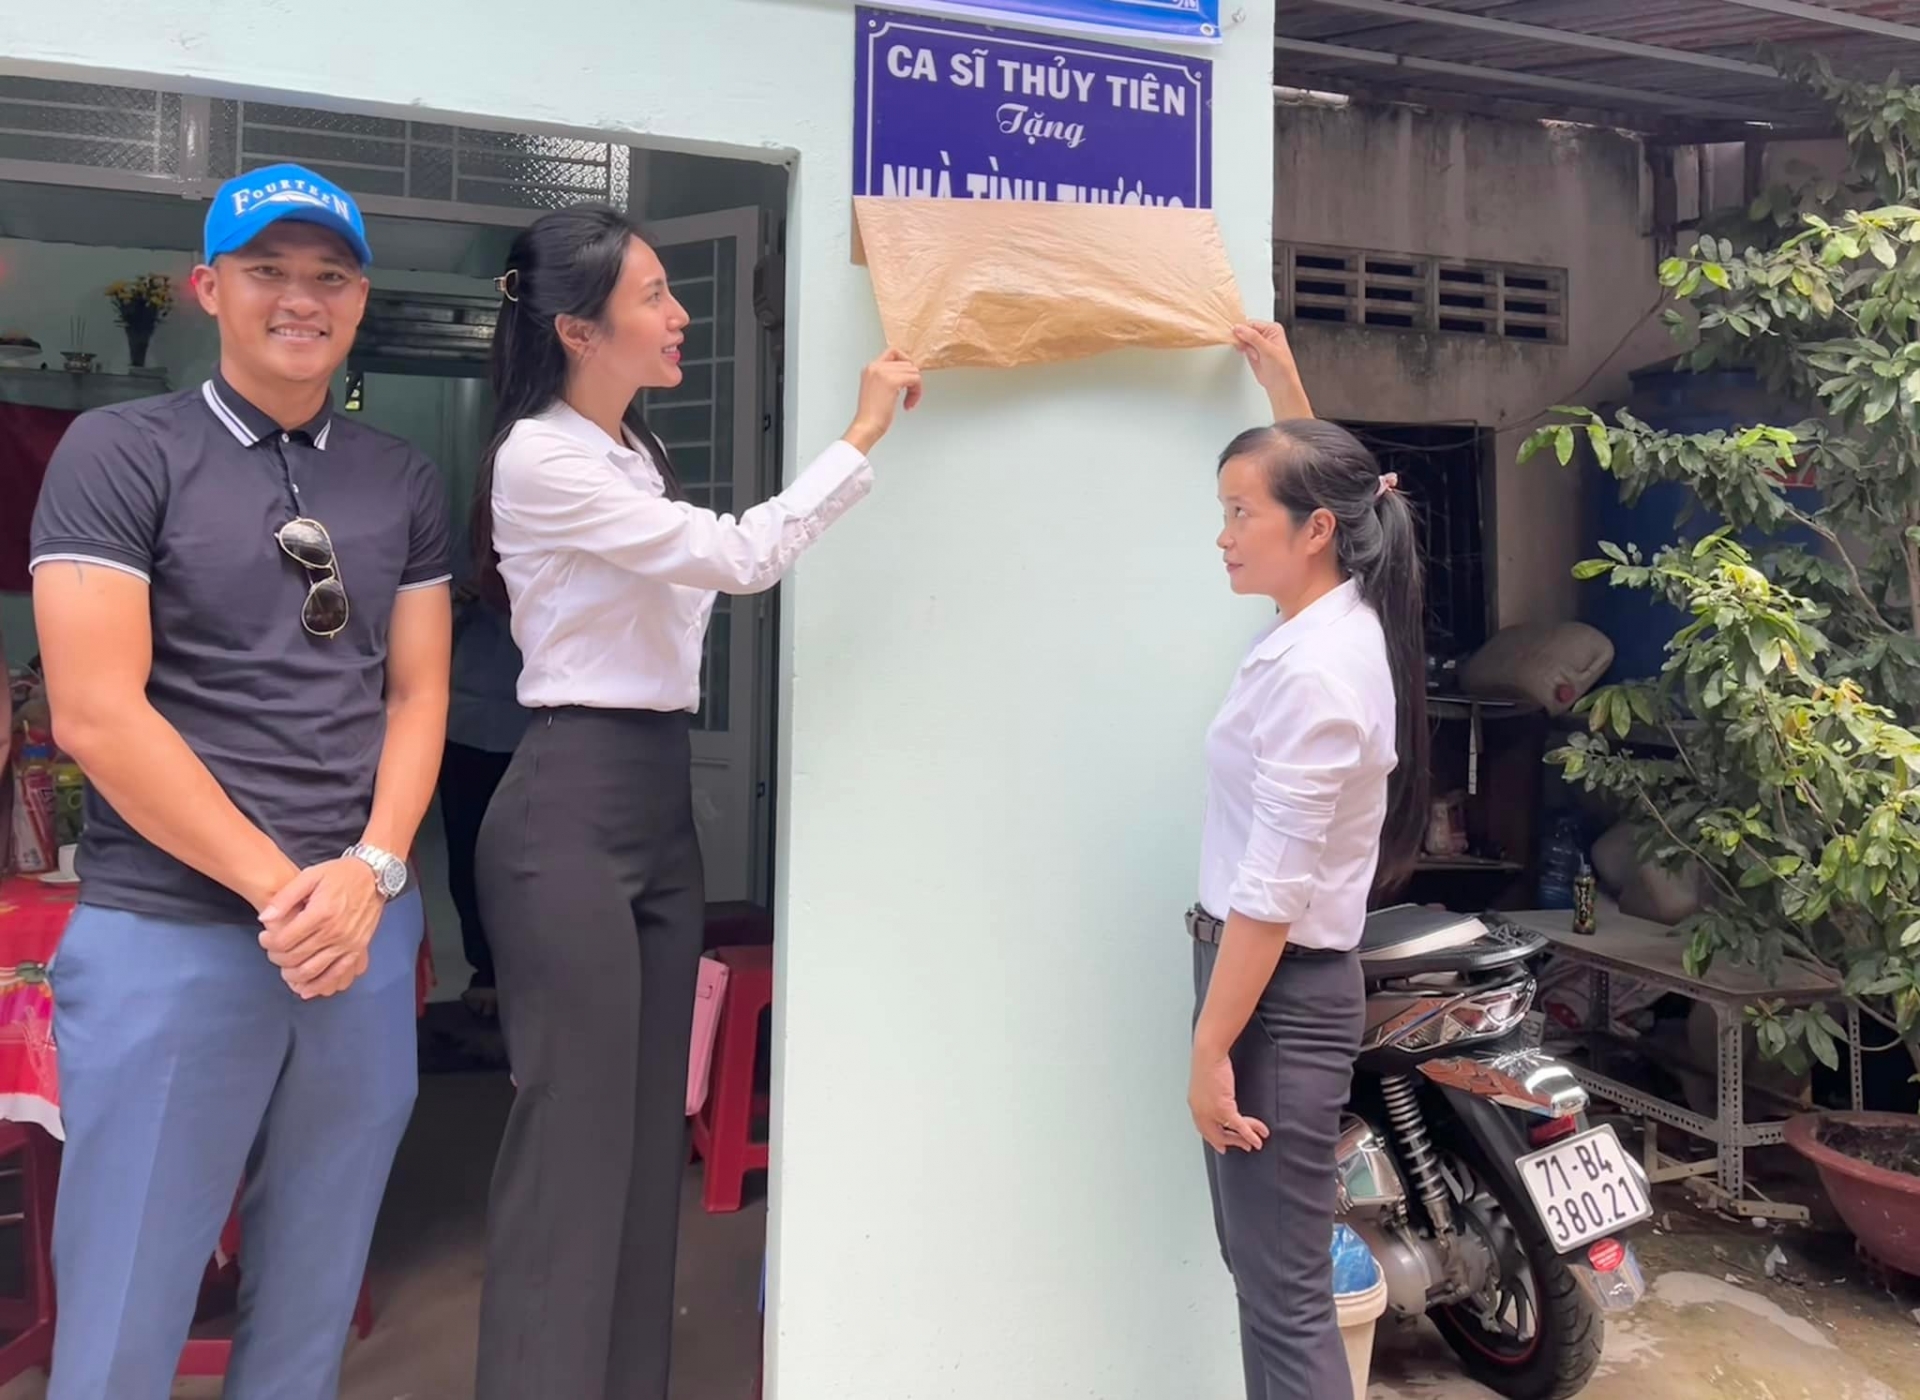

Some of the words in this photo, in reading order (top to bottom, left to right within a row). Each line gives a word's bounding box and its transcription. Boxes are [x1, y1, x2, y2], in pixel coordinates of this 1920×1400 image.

[887, 45, 937, 82] CA
[949, 48, 989, 88] SĨ
[997, 56, 1096, 102] THỦY
[1106, 74, 1185, 116] TIÊN
[996, 103, 1086, 148] Tặng
[1535, 1139, 1613, 1197] 71-B4
[1547, 1176, 1639, 1240] 380.21
